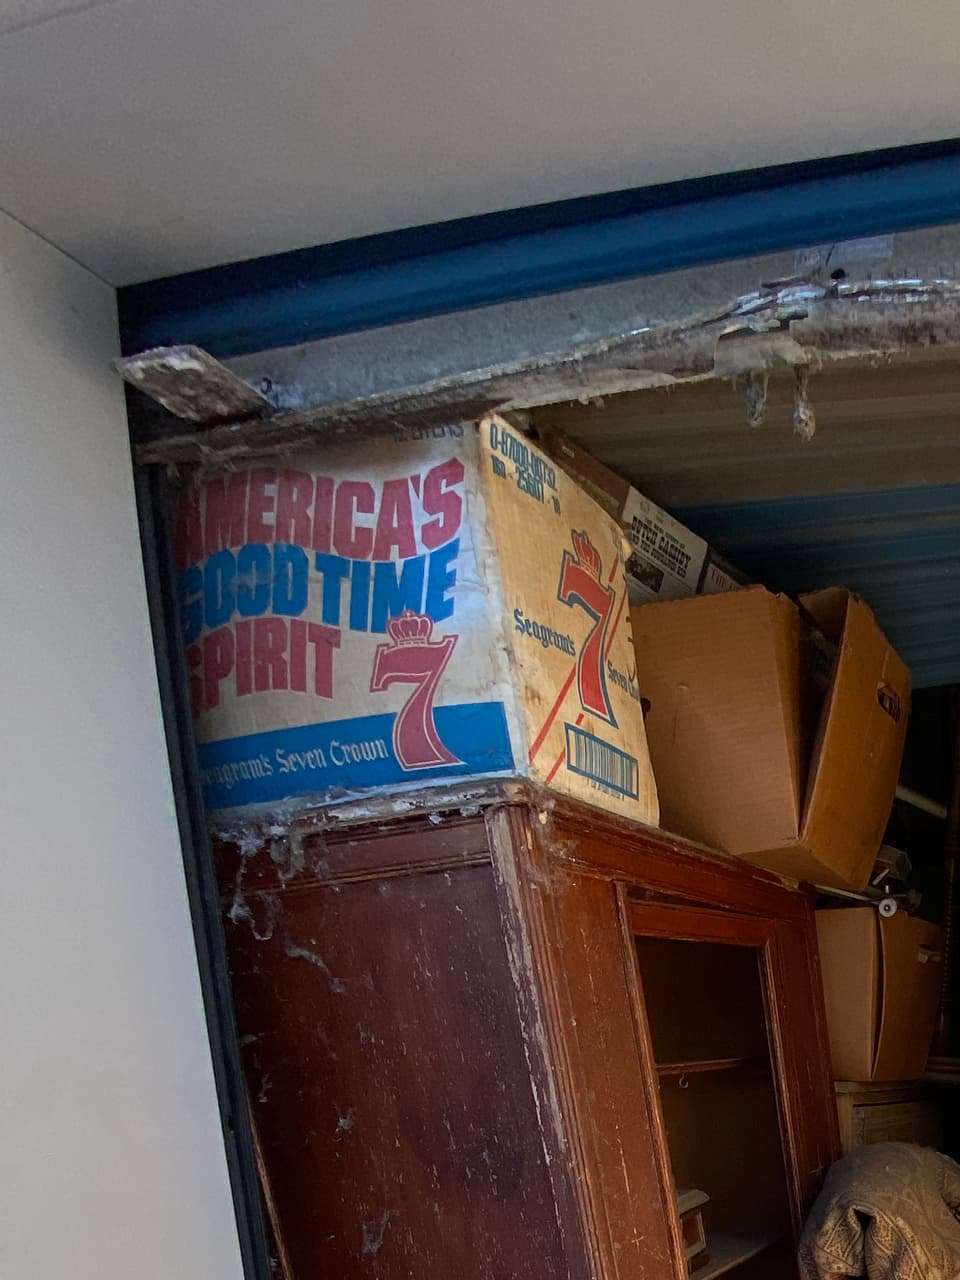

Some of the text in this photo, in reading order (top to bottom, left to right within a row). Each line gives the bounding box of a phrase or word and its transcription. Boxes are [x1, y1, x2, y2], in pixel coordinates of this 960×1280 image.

[176, 457, 465, 570] AMERICA'S
[658, 536, 691, 570] CASSIDY
[178, 538, 461, 644] GOOD TIME
[513, 608, 576, 657] Seagram's
[557, 549, 619, 730] 7
[185, 617, 466, 772] SPIRIT 7
[275, 748, 327, 774] Seven
[329, 738, 390, 767] Crown
